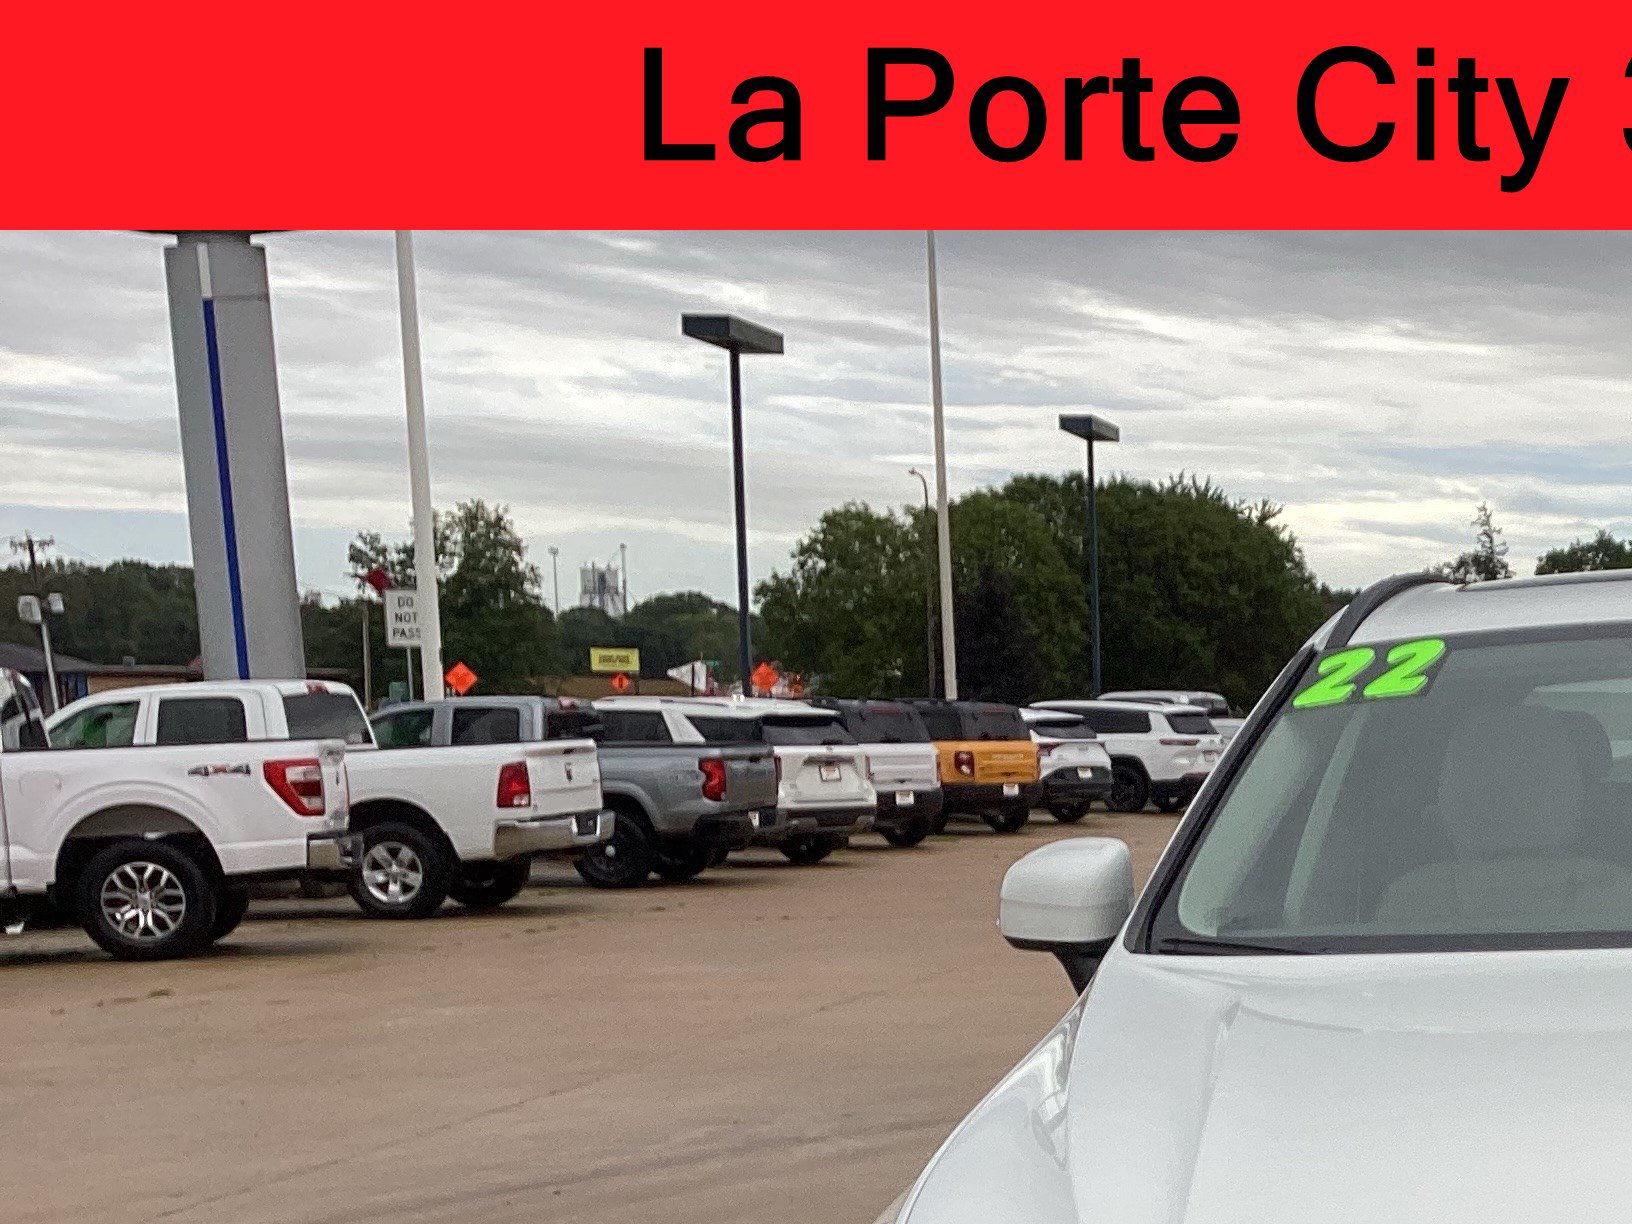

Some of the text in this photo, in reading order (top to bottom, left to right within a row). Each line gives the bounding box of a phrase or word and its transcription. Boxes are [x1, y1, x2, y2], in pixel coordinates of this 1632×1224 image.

[398, 596, 414, 608] DO
[395, 611, 417, 623] NOT
[392, 627, 421, 639] PASS
[1292, 638, 1446, 709] 22
